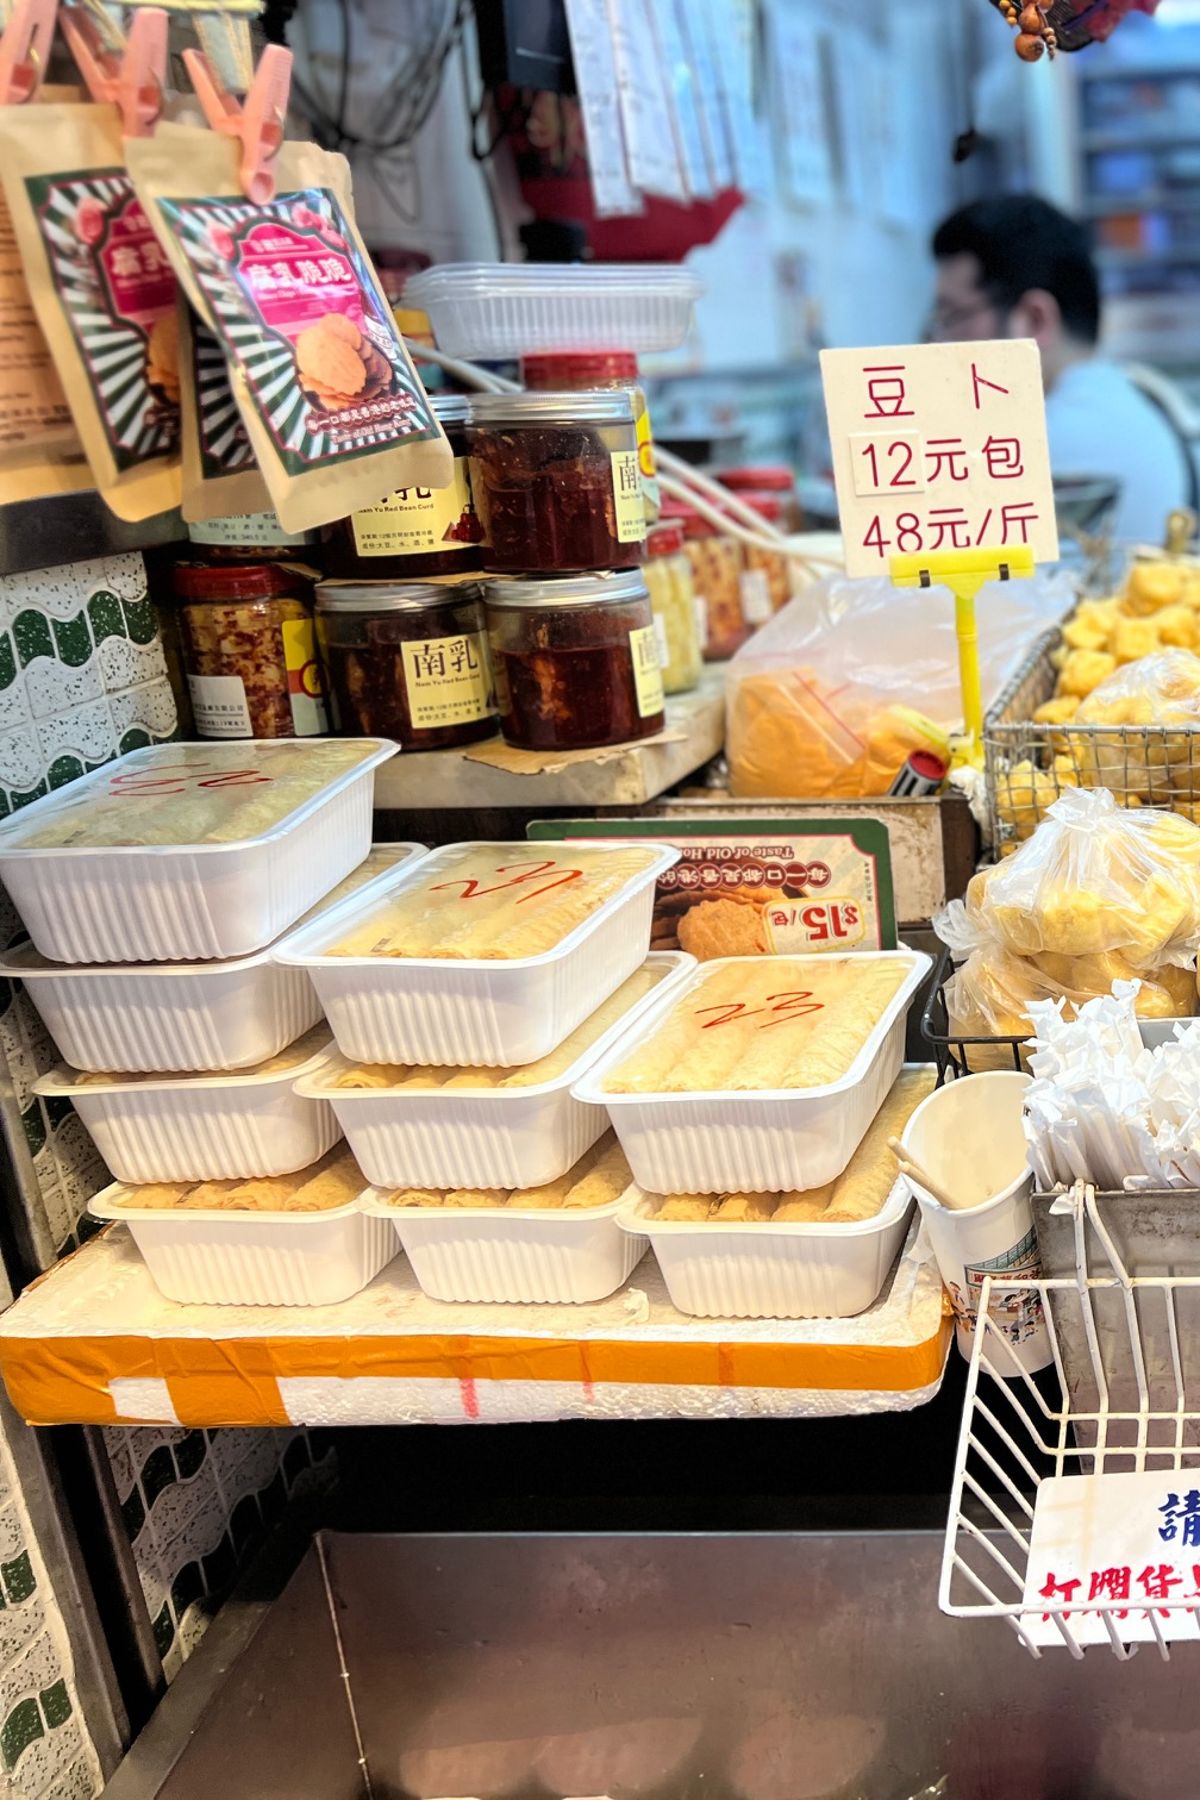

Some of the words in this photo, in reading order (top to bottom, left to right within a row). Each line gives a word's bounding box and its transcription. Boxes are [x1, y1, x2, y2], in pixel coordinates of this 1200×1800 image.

[862, 362, 1009, 419] 豆卜
[861, 435, 1024, 487] 12元包
[862, 501, 1039, 558] 48元/斤
[409, 639, 478, 679] 南乳
[706, 846, 733, 860] Old
[735, 845, 750, 860] of
[754, 845, 795, 859] Taste
[694, 990, 825, 1029] 23
